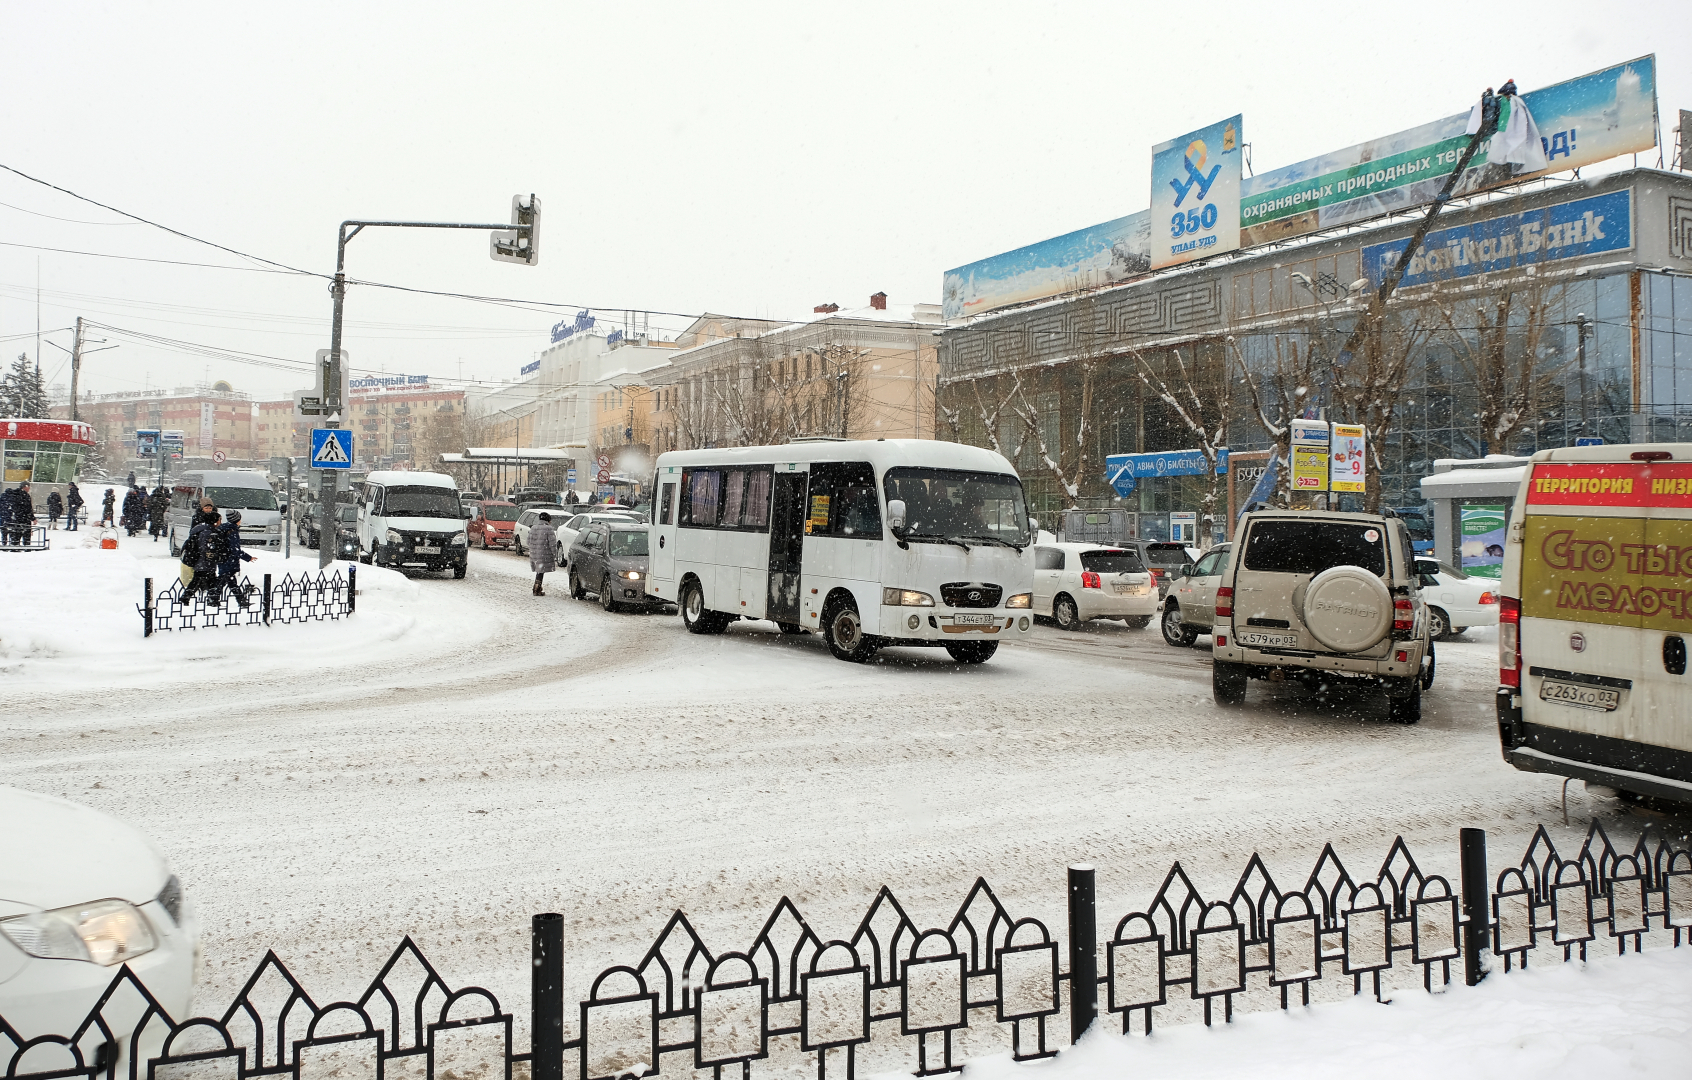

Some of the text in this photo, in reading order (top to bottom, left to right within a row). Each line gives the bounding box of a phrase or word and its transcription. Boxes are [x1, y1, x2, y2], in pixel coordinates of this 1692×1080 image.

[1243, 183, 1333, 219] охраняемых
[1337, 155, 1431, 194] природных
[1170, 203, 1218, 239] 350
[1171, 234, 1218, 256] УЛАН-УДЭ
[1168, 458, 1196, 469] БИЛЕТЫ
[1352, 461, 1360, 475] 9
[1535, 477, 1634, 494] ТЕРРИТОРИЯ
[1316, 600, 1379, 618] PATRIOT
